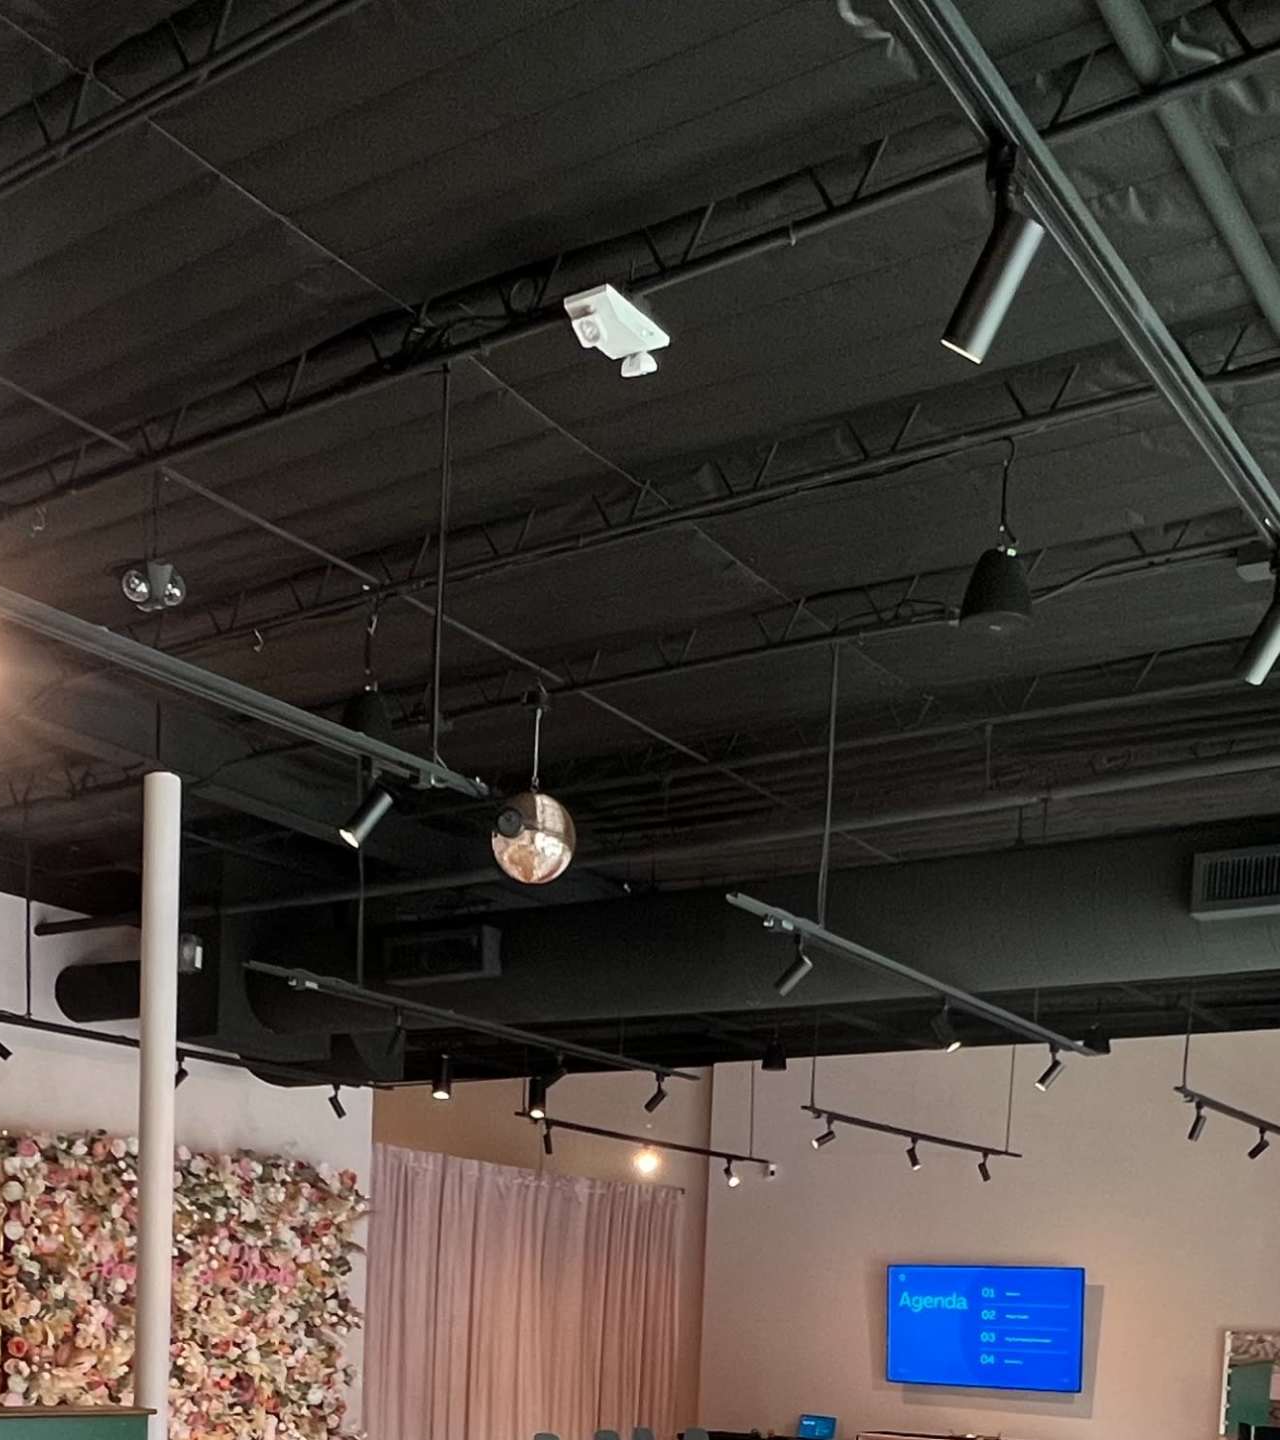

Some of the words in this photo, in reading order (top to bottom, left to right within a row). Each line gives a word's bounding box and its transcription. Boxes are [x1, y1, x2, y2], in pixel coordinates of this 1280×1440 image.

[982, 1287, 995, 1298] 01
[899, 1291, 968, 1312] Agenda
[981, 1309, 996, 1320] 02
[980, 1331, 996, 1343] 03
[980, 1354, 995, 1364] 04
